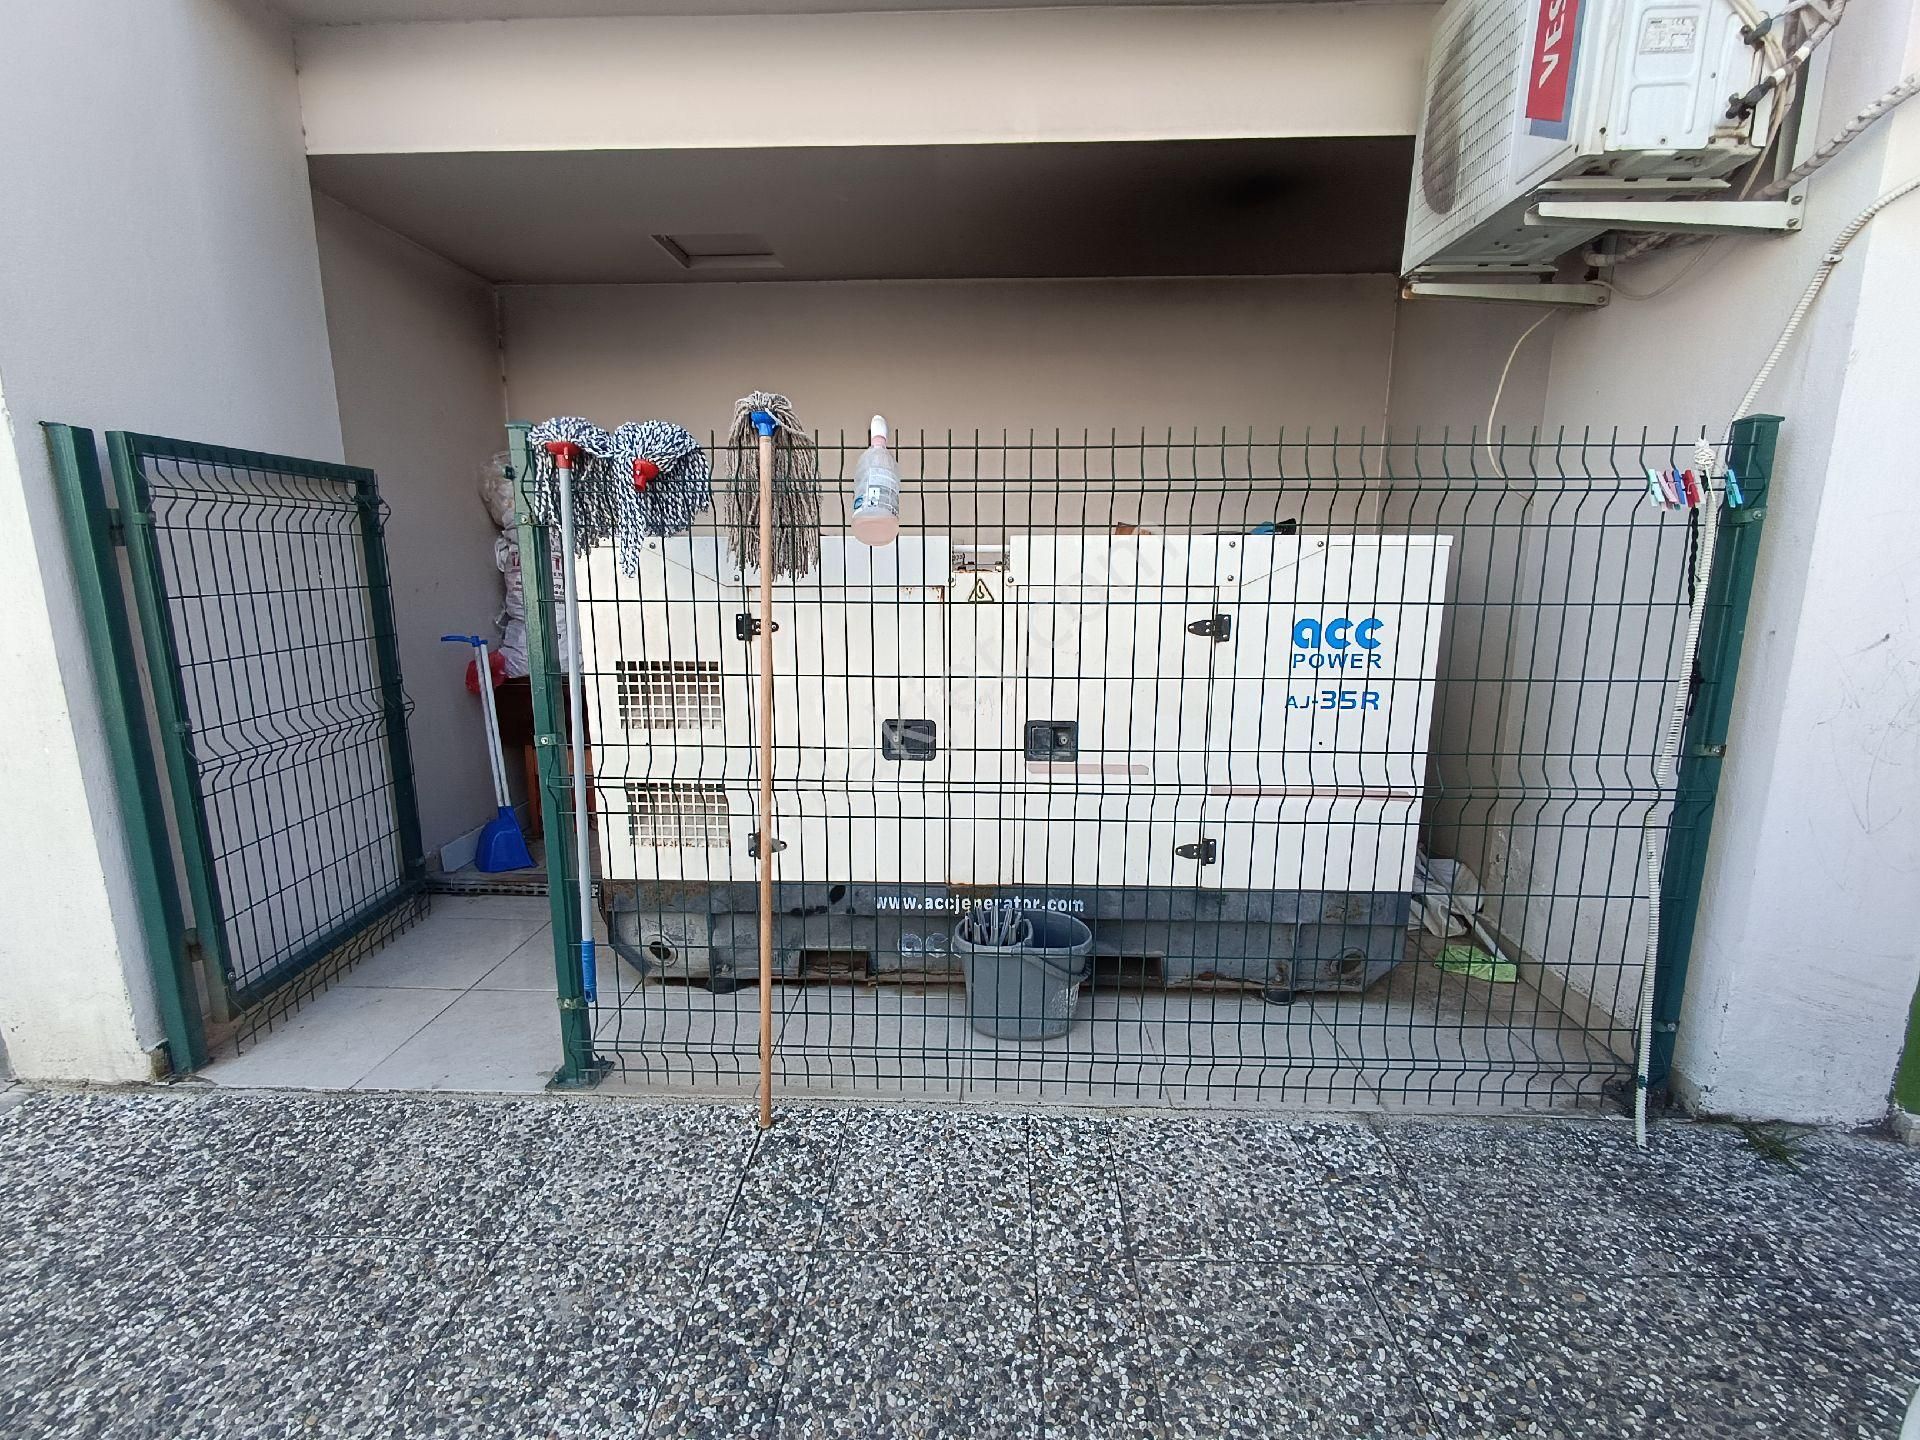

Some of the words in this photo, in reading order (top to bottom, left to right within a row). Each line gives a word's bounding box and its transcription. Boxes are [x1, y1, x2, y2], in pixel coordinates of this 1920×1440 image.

[1293, 617, 1384, 649] acc
[1292, 653, 1382, 669] POWER
[1285, 690, 1380, 710] AJ-35R
